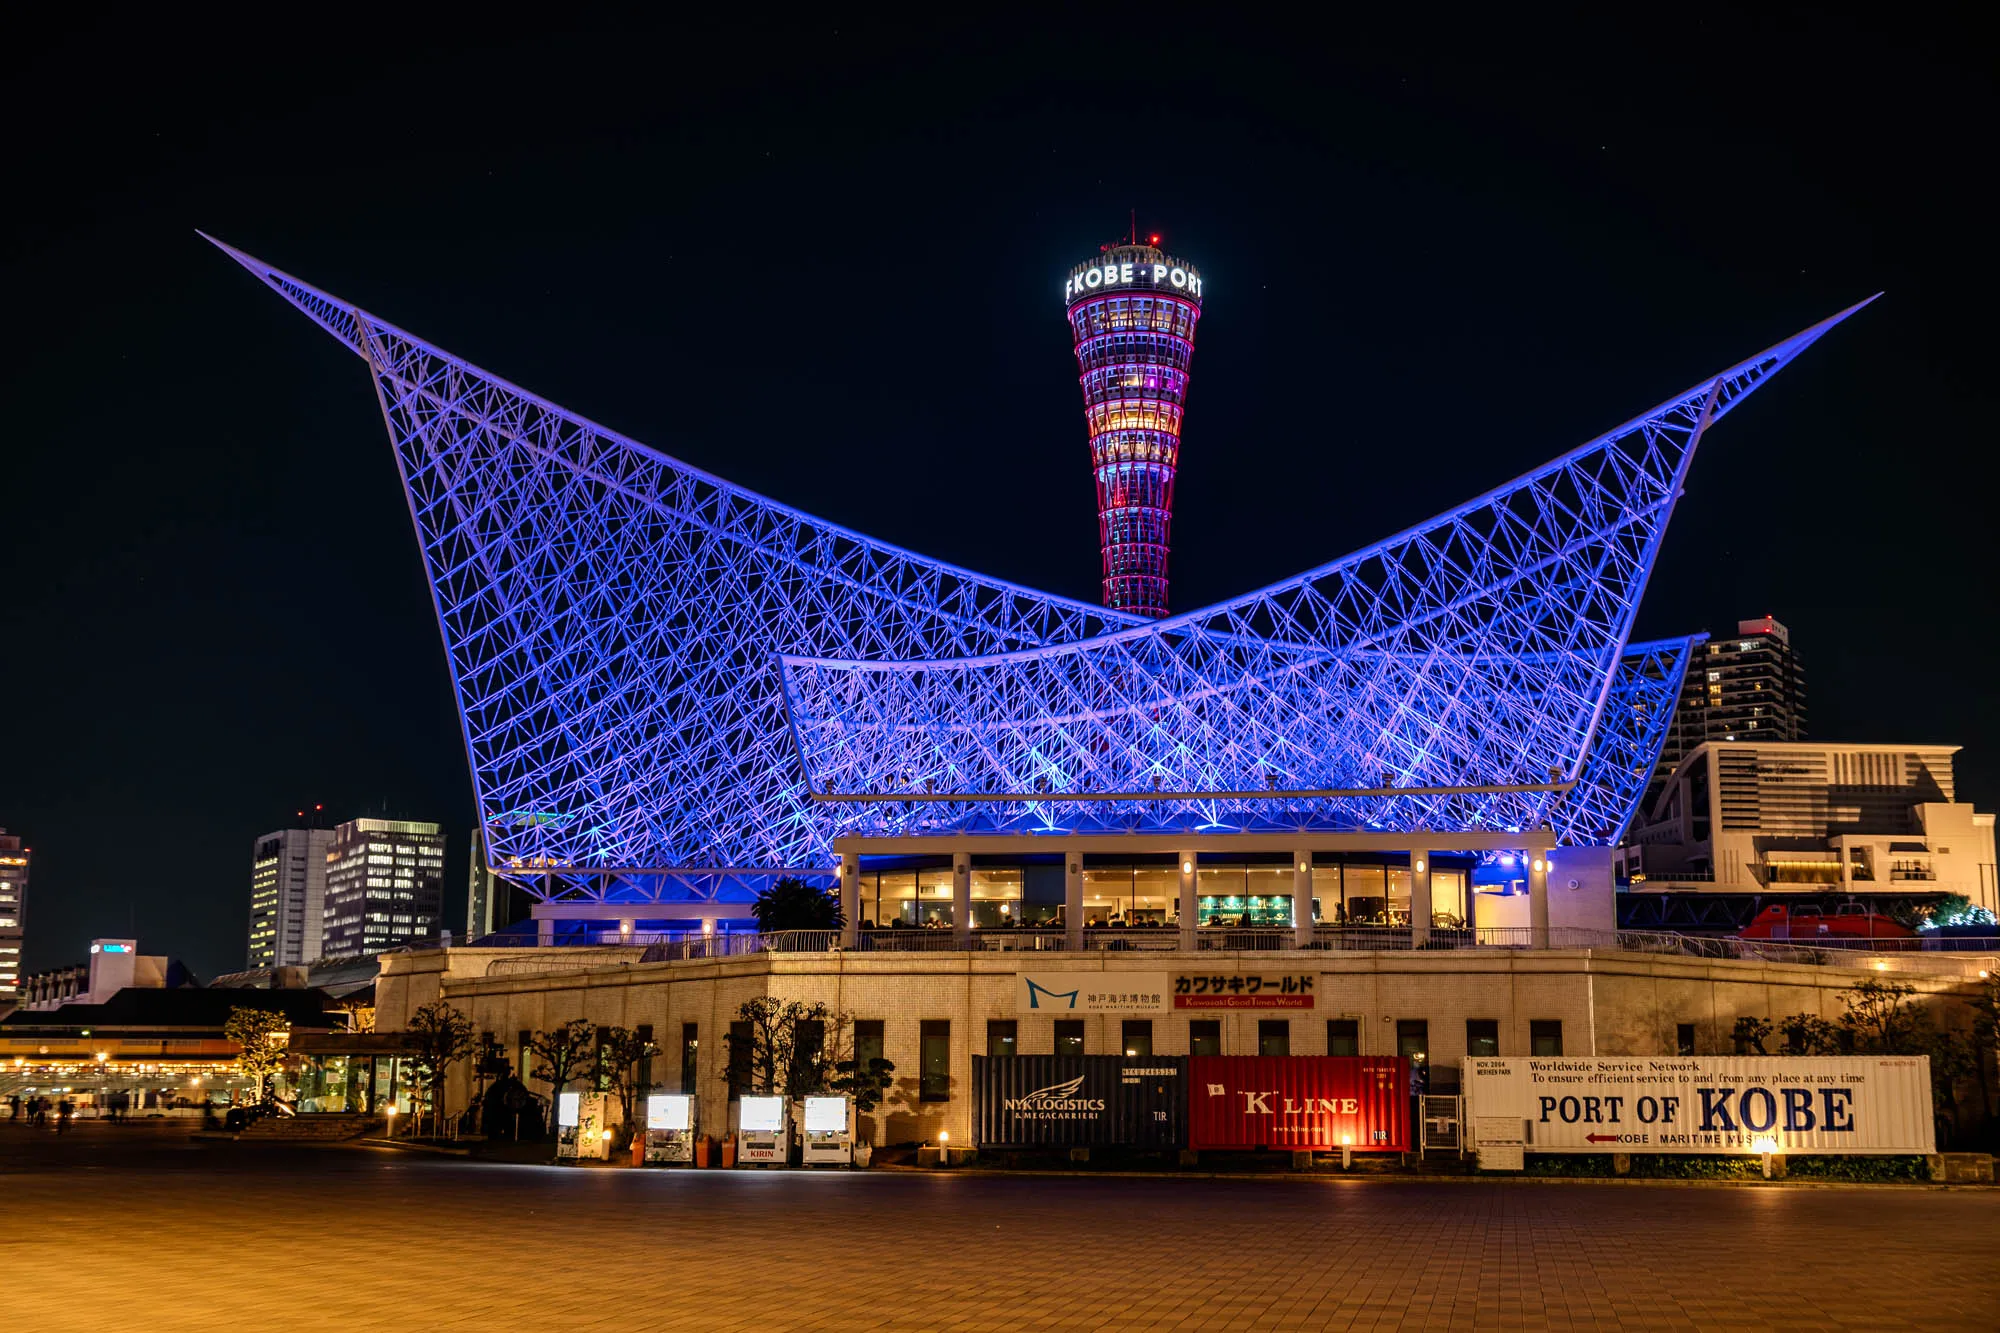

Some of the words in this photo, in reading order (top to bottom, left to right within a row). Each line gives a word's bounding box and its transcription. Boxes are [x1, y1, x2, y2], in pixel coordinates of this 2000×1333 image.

[1074, 263, 1134, 294] KOBE
[1153, 264, 1201, 297] PORT
[1175, 976, 1313, 993] カワサキワールド
[1087, 994, 1160, 1004] 神戸海洋博物館
[1227, 997, 1251, 1007] Good
[1276, 997, 1303, 1007] World
[1530, 1061, 1593, 1071] Worldwide
[1597, 1061, 1643, 1071] Service
[1649, 1060, 1700, 1071] Network
[1531, 1073, 1545, 1082] To
[1548, 1074, 1584, 1082] ensure
[1588, 1073, 1634, 1083] efficient
[1636, 1074, 1673, 1082] service
[1679, 1074, 1690, 1082] to
[1694, 1073, 1713, 1083] and
[1719, 1073, 1744, 1083] from
[1748, 1075, 1767, 1085] any
[1772, 1073, 1800, 1085] place
[1803, 1075, 1815, 1083] at
[1817, 1075, 1836, 1085] any
[1841, 1073, 1865, 1083] time
[1005, 1099, 1033, 1111] NYK
[1037, 1099, 1105, 1111] LOGISTICS
[1284, 1099, 1358, 1114] LINE
[1539, 1096, 1624, 1123] PORT
[1637, 1096, 1679, 1123] OF
[1697, 1088, 1854, 1132] KOBE
[1015, 1112, 1022, 1120] &
[1024, 1112, 1098, 1120] MEGACARRIERI
[1153, 1111, 1167, 1121] TIR
[1616, 1134, 1649, 1144] KOBE
[1660, 1134, 1721, 1144] MARITIME
